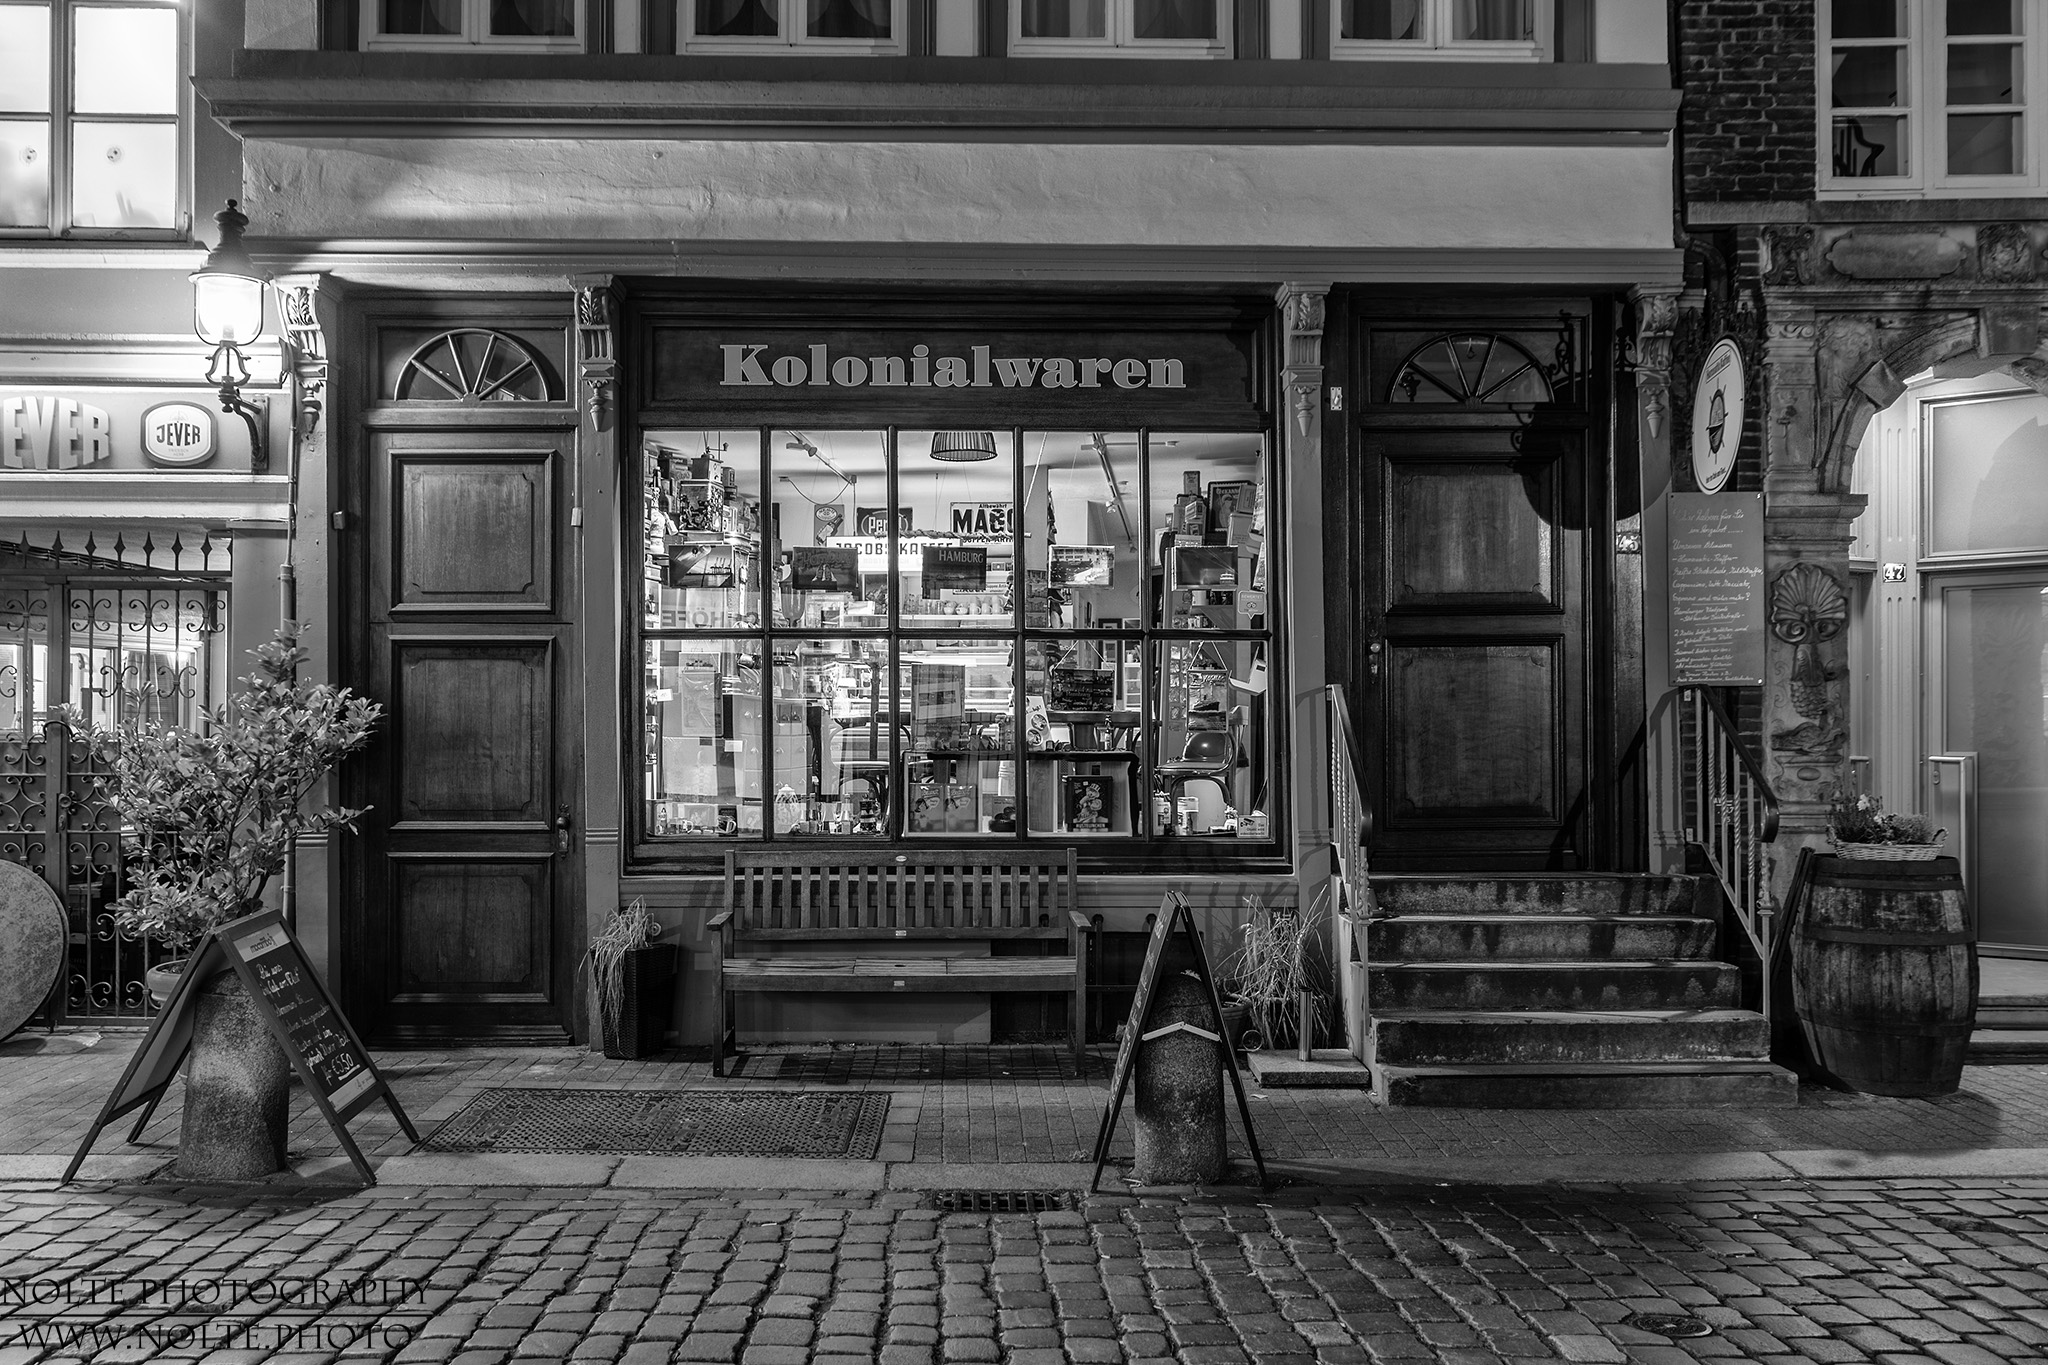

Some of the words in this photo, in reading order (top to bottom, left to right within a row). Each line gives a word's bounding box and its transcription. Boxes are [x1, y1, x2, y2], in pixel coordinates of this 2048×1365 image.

[719, 344, 1187, 389] Kolonialwaren
[156, 422, 201, 446] JEVER
[1619, 536, 1639, 551] 45
[939, 550, 984, 563] HAMBURG
[1885, 565, 1905, 580] 47
